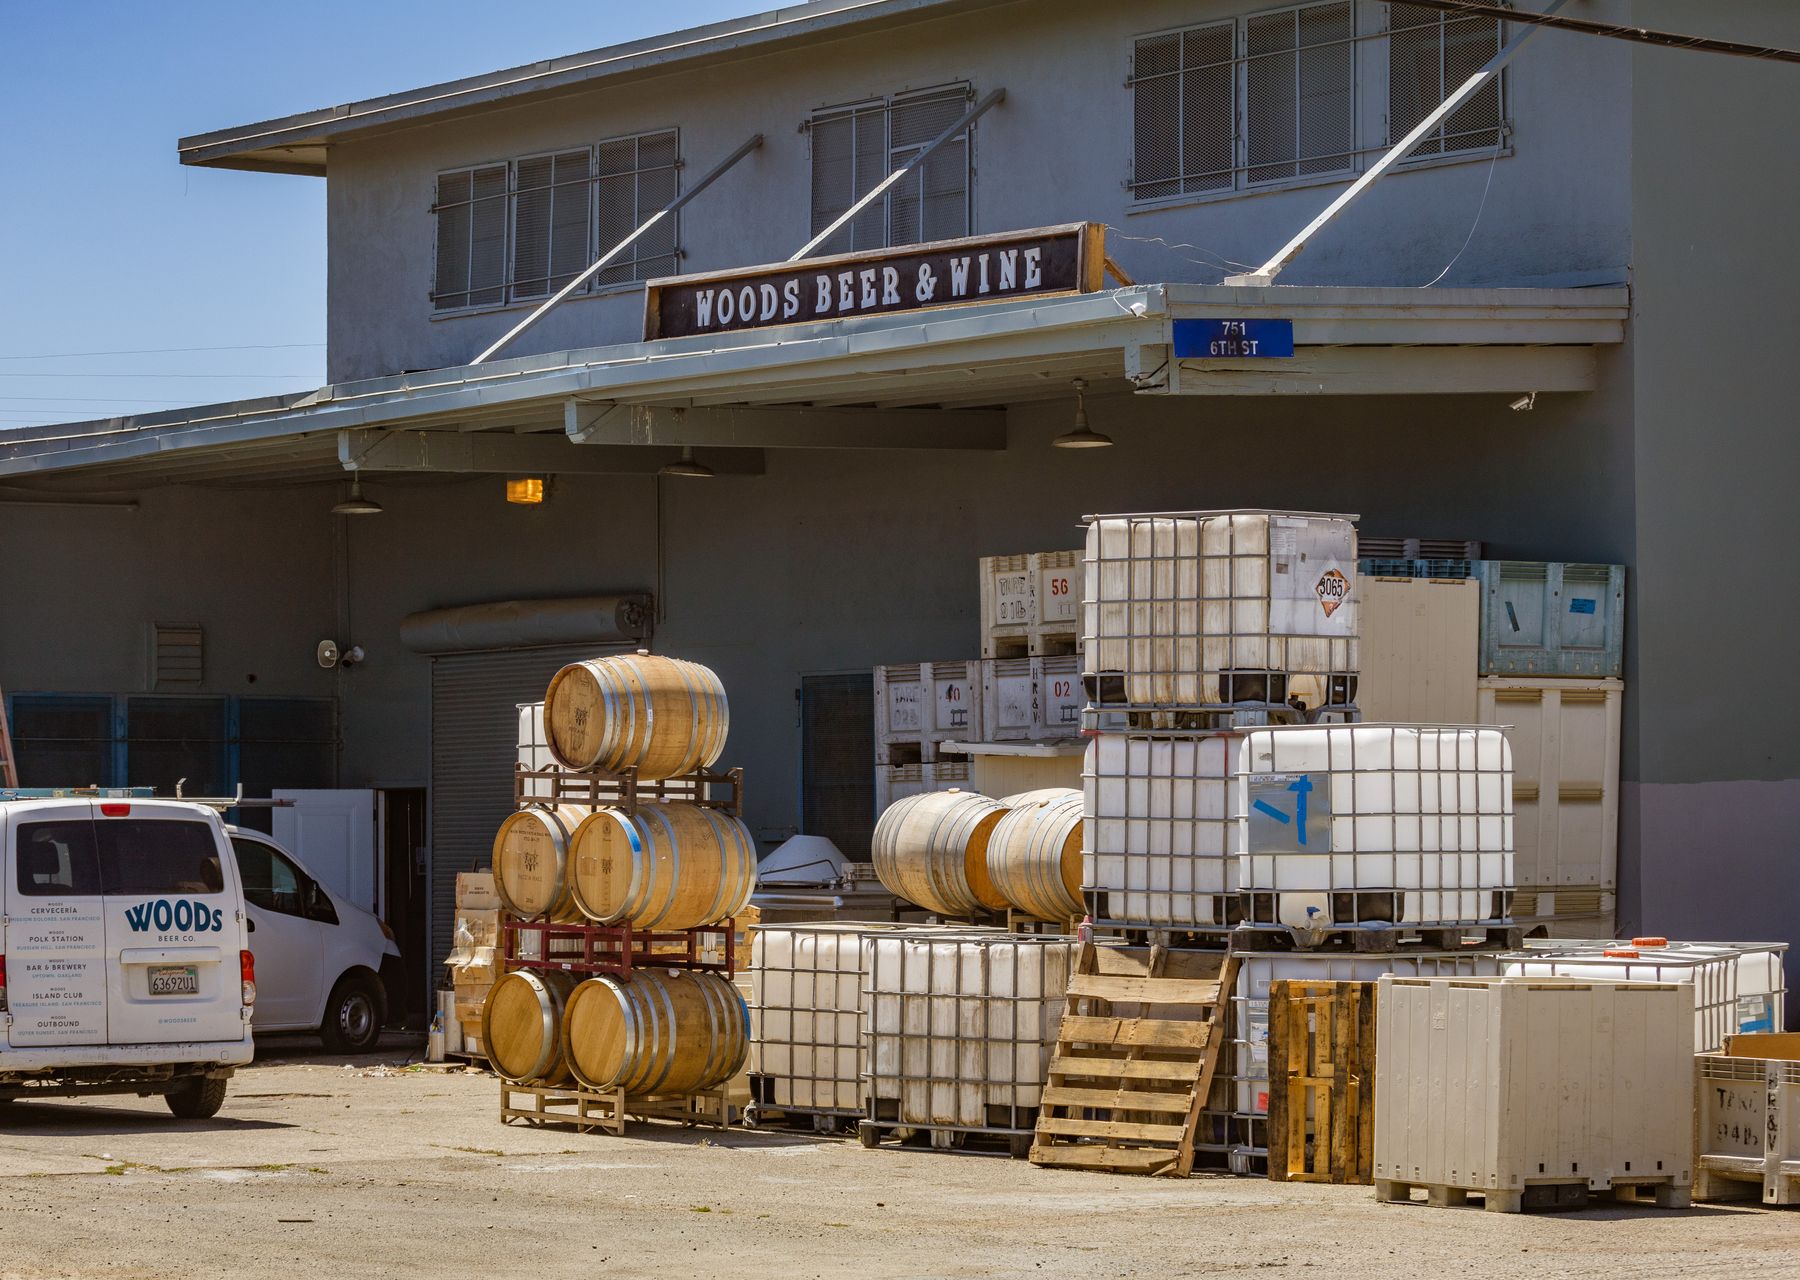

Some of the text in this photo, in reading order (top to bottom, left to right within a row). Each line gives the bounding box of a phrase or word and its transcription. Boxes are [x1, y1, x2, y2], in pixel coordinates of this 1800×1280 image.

[696, 246, 1042, 327] WOODS BEER & WINE
[1222, 321, 1246, 335] 751
[1210, 340, 1259, 355] 6TH ST
[1051, 578, 1069, 596] 56
[1320, 577, 1343, 597] 3065
[1054, 681, 1070, 698] 02
[31, 906, 78, 914] CERVECERÍA
[124, 899, 223, 932] WOODS
[153, 977, 195, 990] 63692U1
